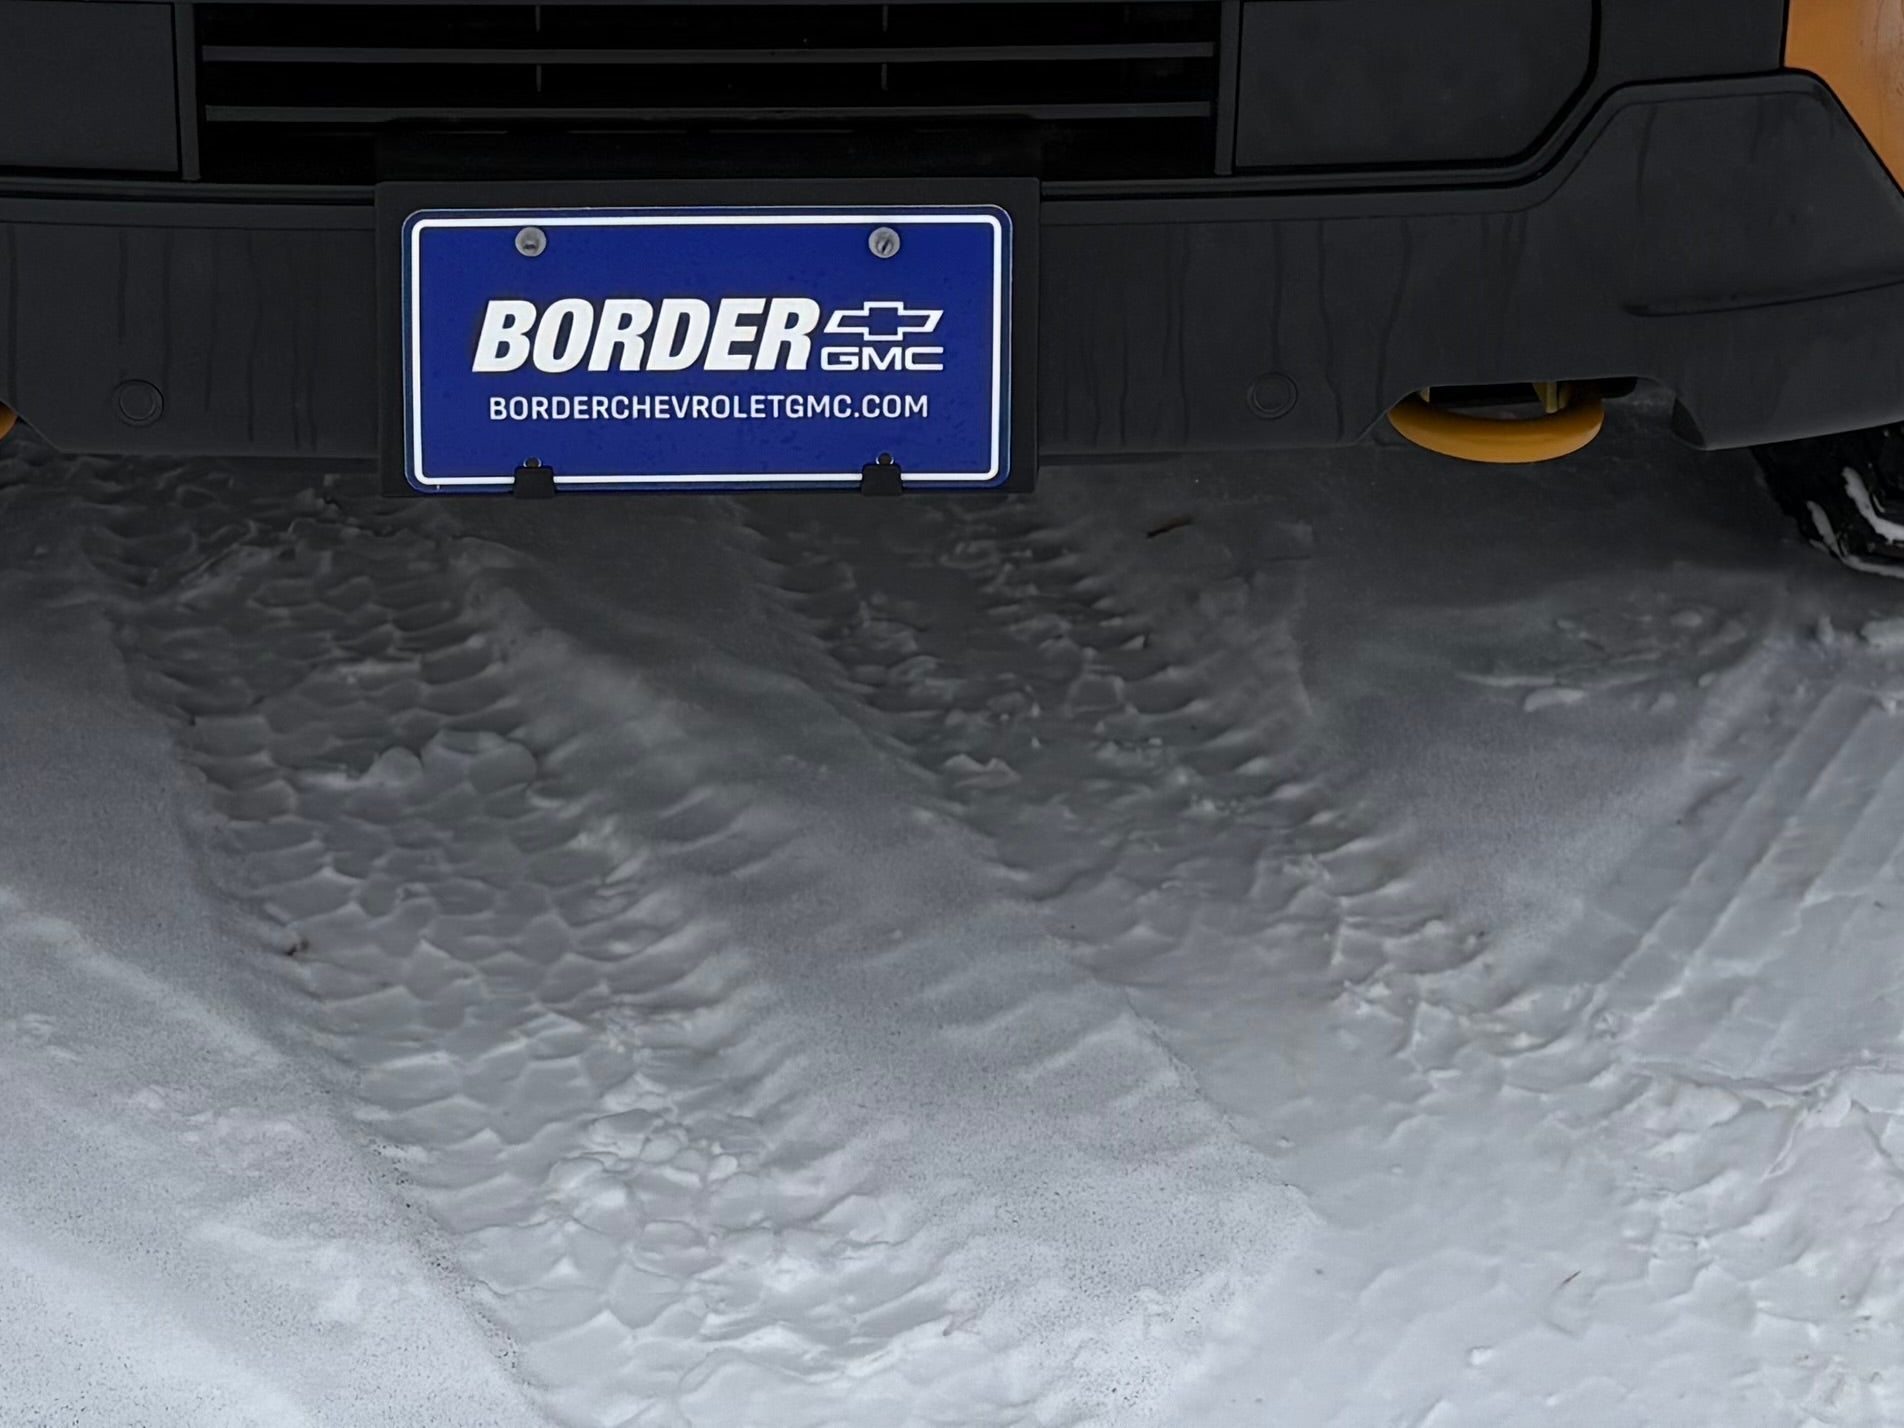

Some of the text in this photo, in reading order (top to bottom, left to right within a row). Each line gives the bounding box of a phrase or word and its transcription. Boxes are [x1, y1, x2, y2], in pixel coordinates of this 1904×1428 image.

[472, 297, 944, 373] BORDER GMC
[489, 394, 928, 420] BORDERCHEVROLETGMC.COM
